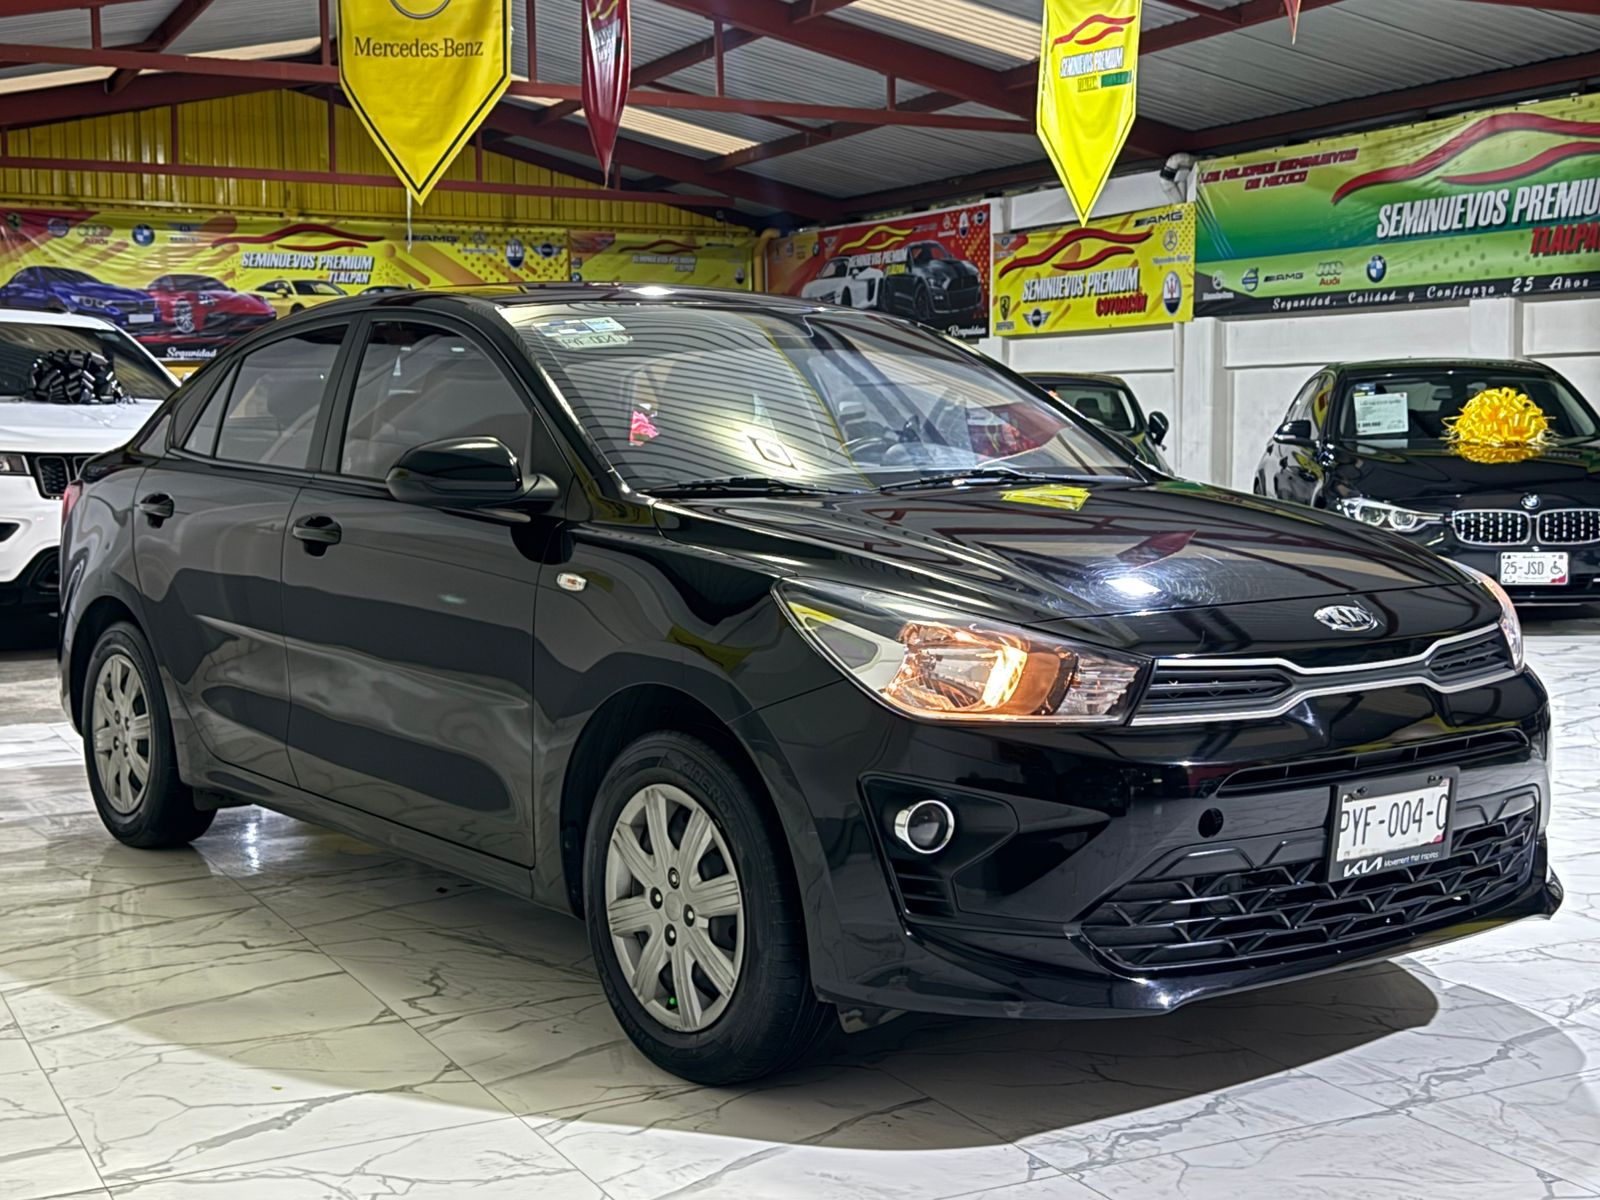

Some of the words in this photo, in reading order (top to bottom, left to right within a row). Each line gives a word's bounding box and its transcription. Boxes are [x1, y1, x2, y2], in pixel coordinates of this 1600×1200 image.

[354, 36, 484, 58] Mercedes-Benz
[1245, 178, 1261, 190] DE
[1147, 211, 1183, 224] AMG
[1376, 188, 1510, 239] SEMINUEVOS
[1511, 176, 1600, 224] PREMIU
[1530, 221, 1600, 257] TLALPA
[242, 252, 316, 270] SEMINUEVOS
[318, 255, 374, 271] PREMIUM
[328, 272, 370, 285] TLALPAN
[1022, 275, 1085, 301] SEMINUEVOS
[1086, 267, 1140, 296] PREMIUM
[1319, 278, 1341, 287] Audi
[1347, 289, 1397, 305] Calidad
[1408, 291, 1416, 302] y
[1511, 276, 1535, 293] 25
